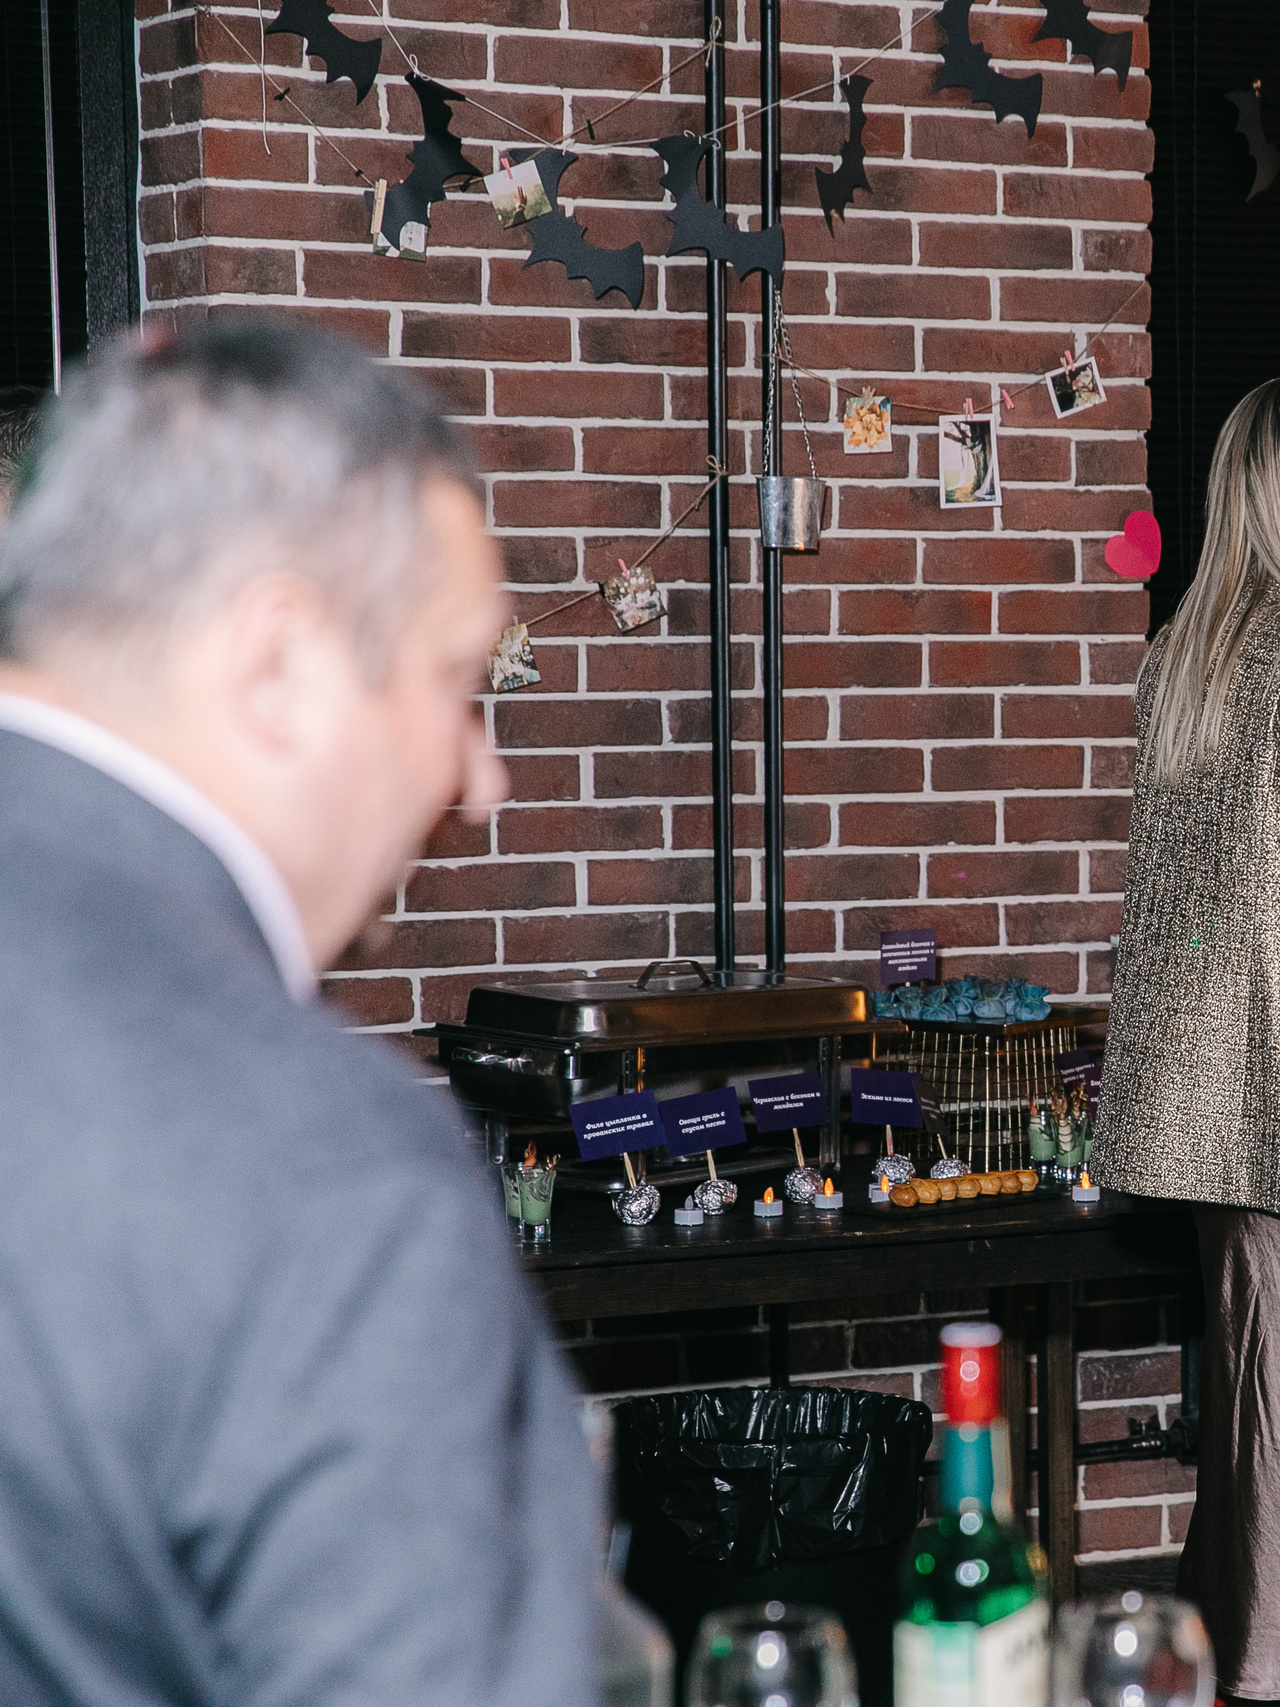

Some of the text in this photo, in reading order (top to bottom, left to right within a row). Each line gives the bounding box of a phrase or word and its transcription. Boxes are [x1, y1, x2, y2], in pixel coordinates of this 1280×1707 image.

[753, 1096, 785, 1105] Чернослив
[790, 1092, 815, 1100] беконом
[860, 1093, 884, 1101] Эскимо
[892, 1096, 913, 1104] лосося
[773, 1102, 804, 1110] миндалем
[585, 1122, 604, 1130] Филе
[605, 1114, 641, 1127] цыпленка
[678, 1116, 701, 1126] Овощи
[701, 1112, 720, 1122] гриль
[583, 1120, 654, 1140] прованских травах
[681, 1119, 726, 1134] соусом песто
